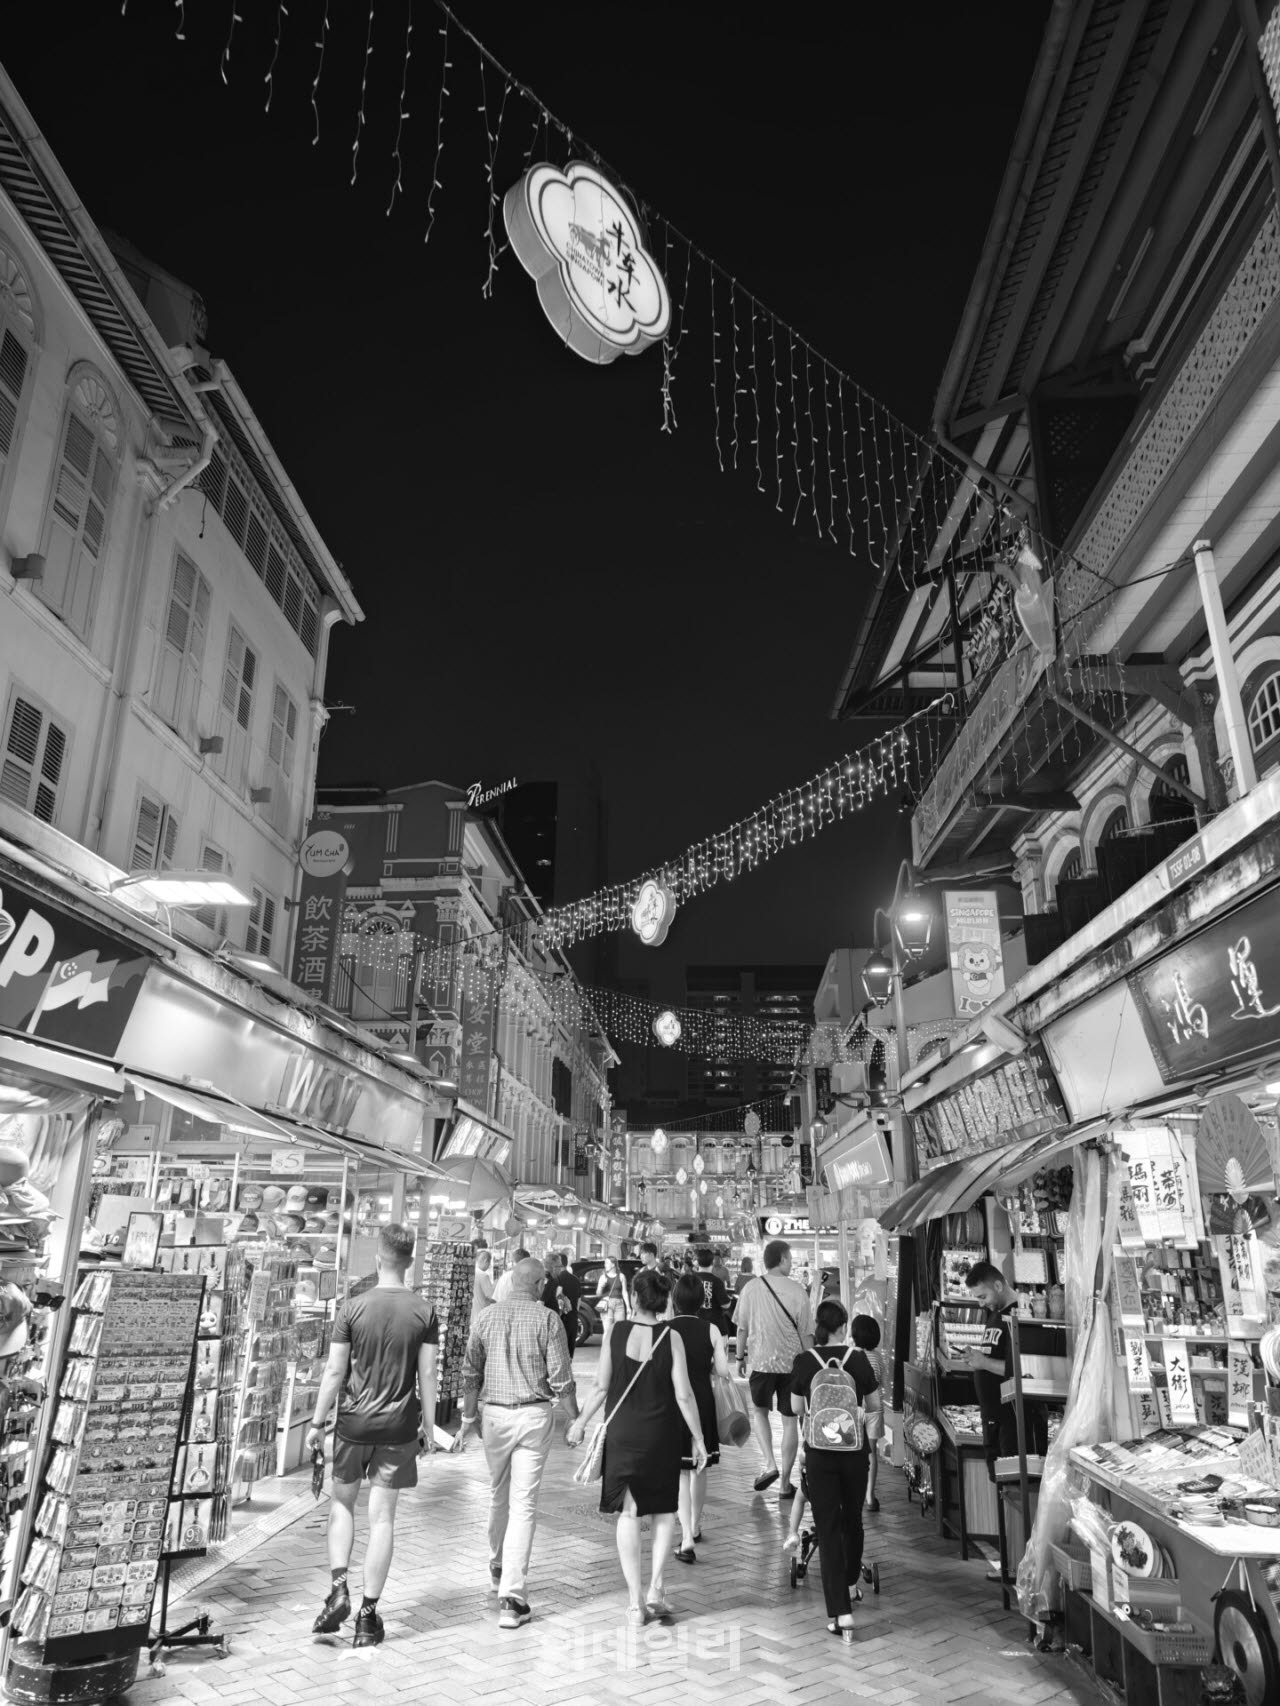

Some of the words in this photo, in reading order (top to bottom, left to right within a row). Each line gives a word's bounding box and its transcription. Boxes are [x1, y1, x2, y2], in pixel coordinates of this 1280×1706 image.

[606, 221, 641, 314] 牛車水
[324, 849, 340, 857] CHA
[441, 1222, 466, 1239] $2
